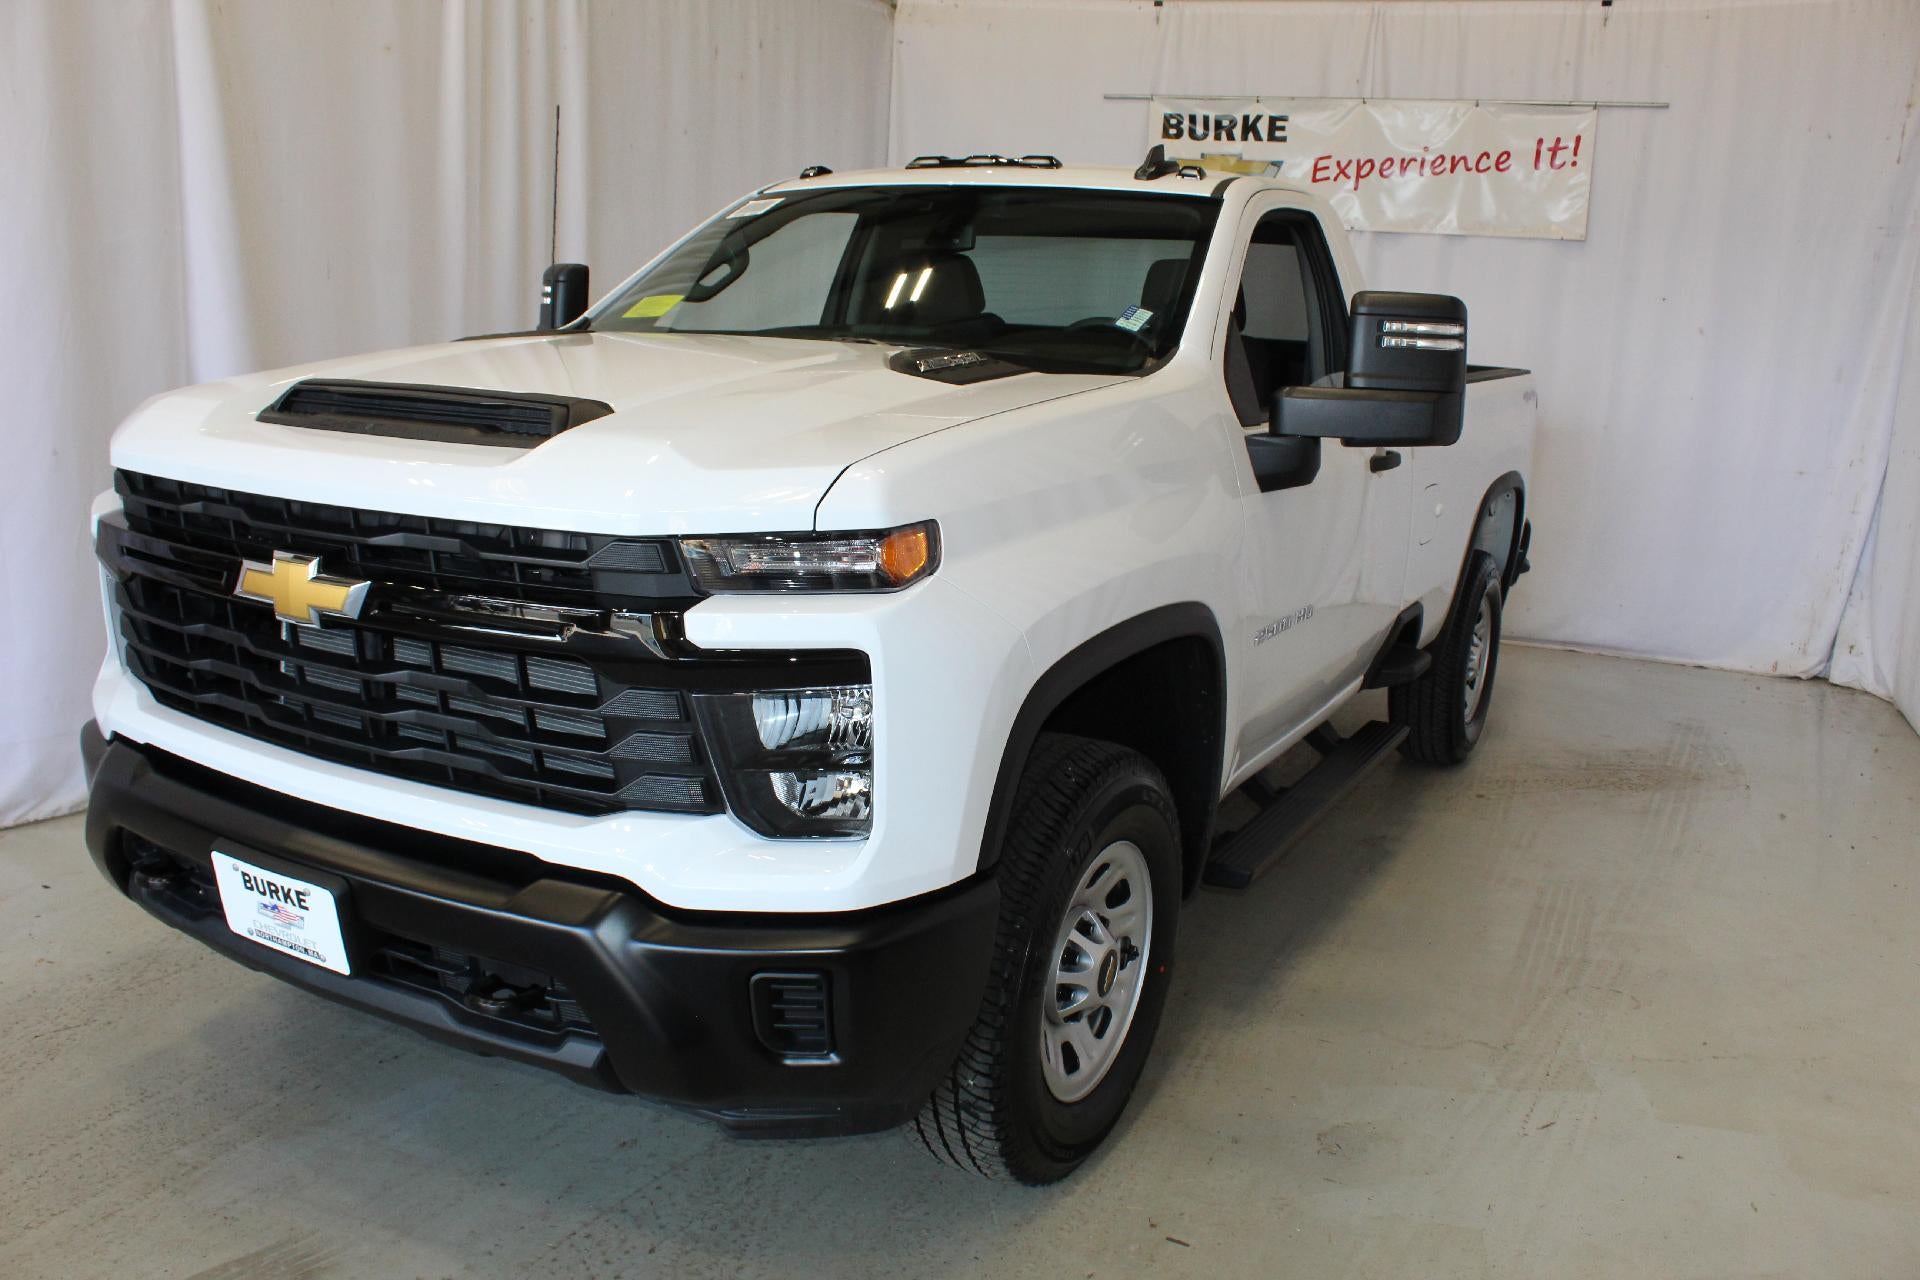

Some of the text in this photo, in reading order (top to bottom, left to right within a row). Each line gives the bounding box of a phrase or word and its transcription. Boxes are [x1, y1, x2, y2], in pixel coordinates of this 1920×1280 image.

[1162, 112, 1289, 142] BURKE
[1311, 135, 1582, 191] Experience It!
[242, 872, 309, 911] BURKE
